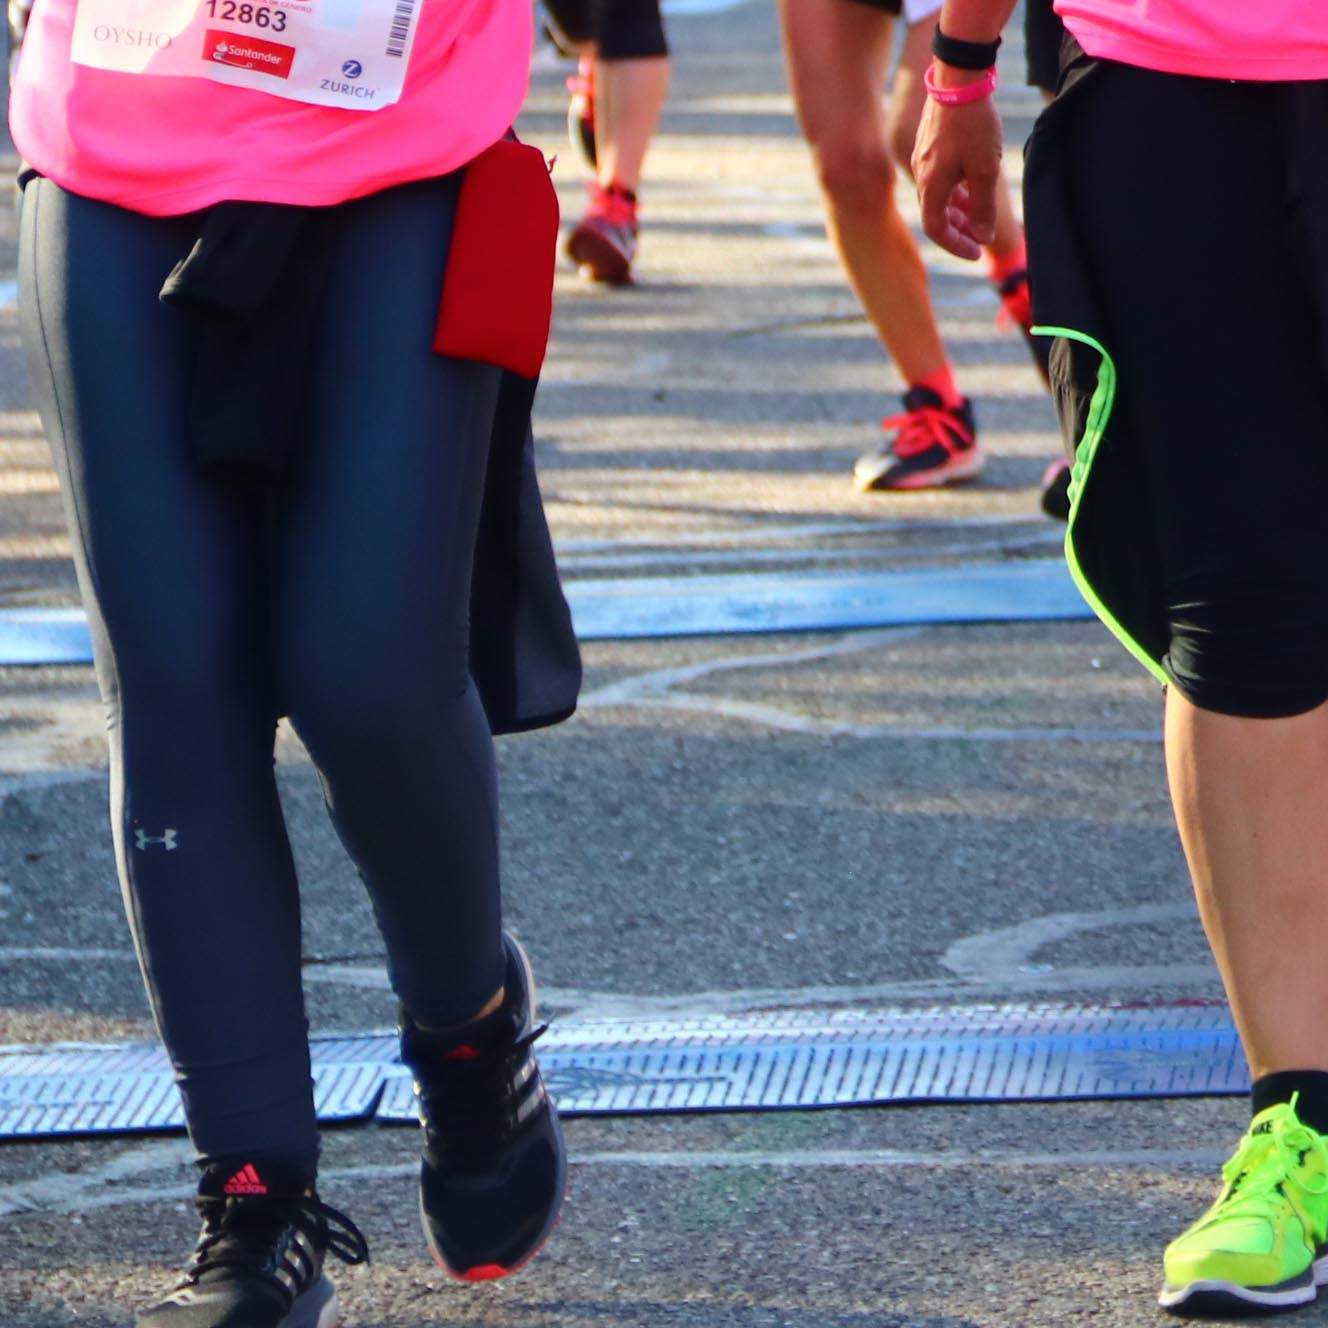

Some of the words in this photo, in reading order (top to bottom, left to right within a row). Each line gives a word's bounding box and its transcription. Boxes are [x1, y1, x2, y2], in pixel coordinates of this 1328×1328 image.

[93, 24, 172, 50] OYSHO
[228, 43, 283, 66] Santander
[320, 79, 375, 100] ZURICH
[224, 1183, 268, 1195] adidas
